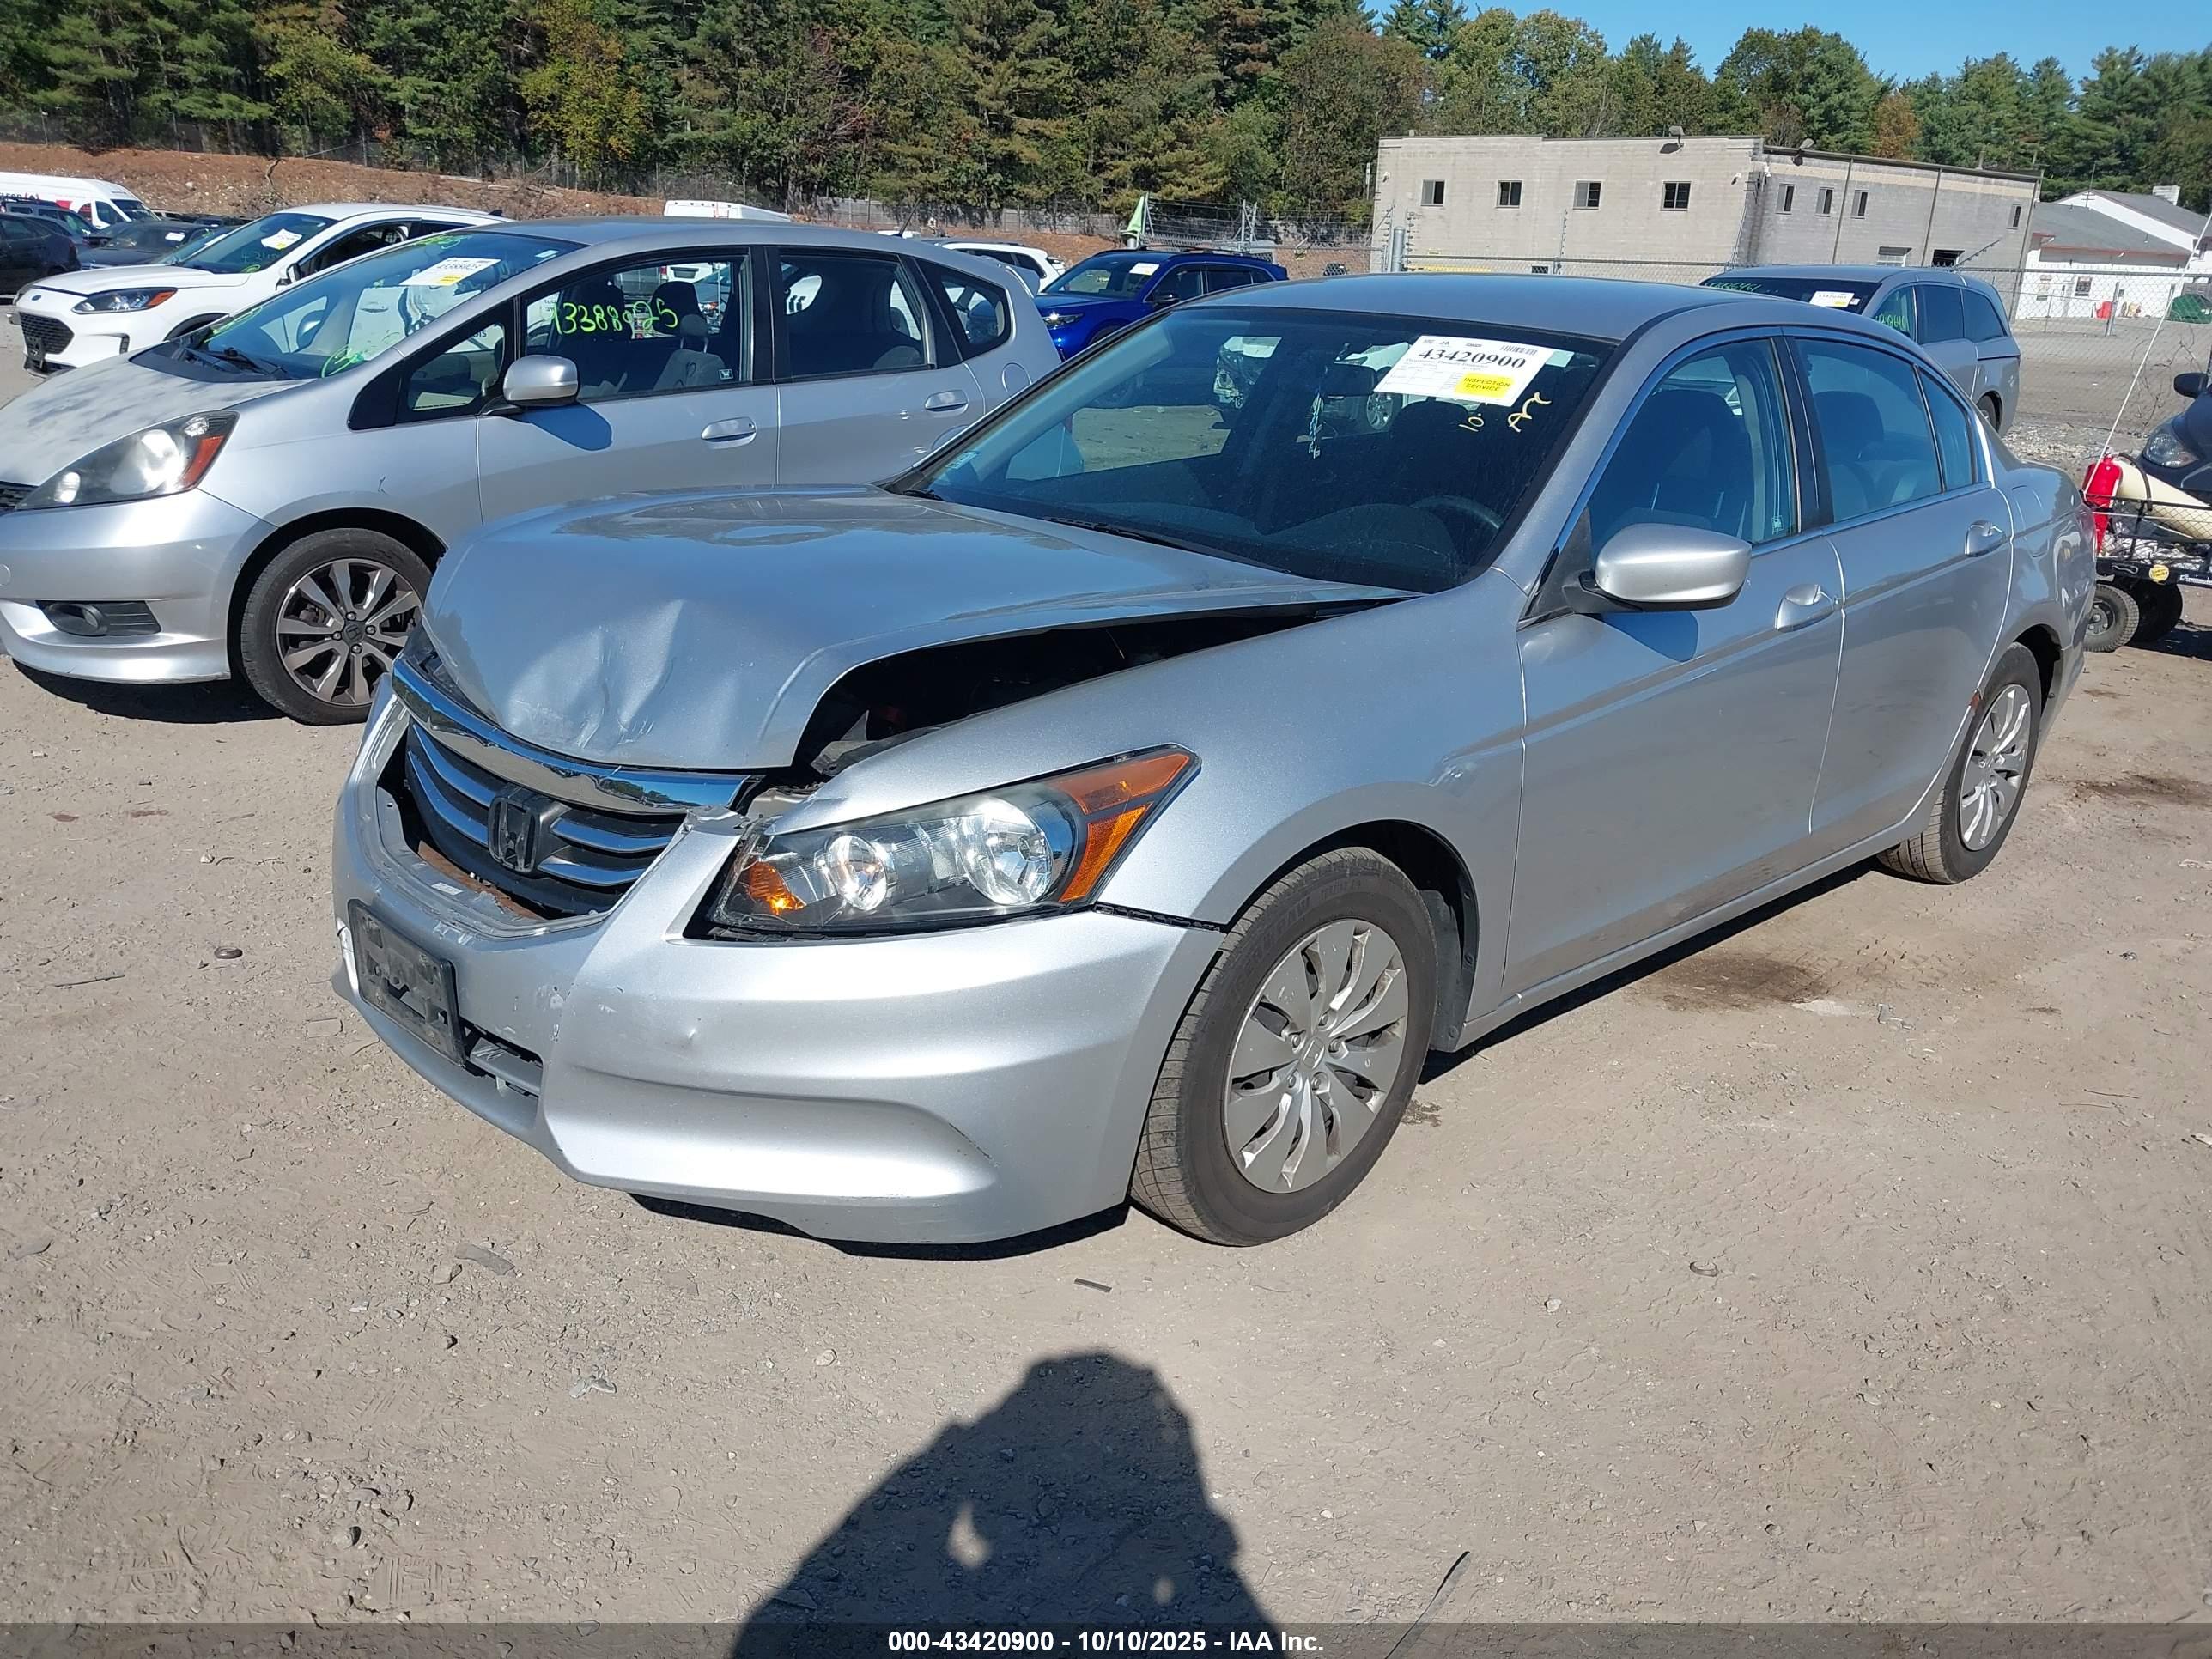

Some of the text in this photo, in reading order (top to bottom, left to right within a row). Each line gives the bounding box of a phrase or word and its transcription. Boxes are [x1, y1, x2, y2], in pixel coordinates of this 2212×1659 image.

[1419, 349, 1527, 370] 43420900
[1463, 377, 1511, 387] INSPECTION
[1465, 383, 1502, 392] SERVICE
